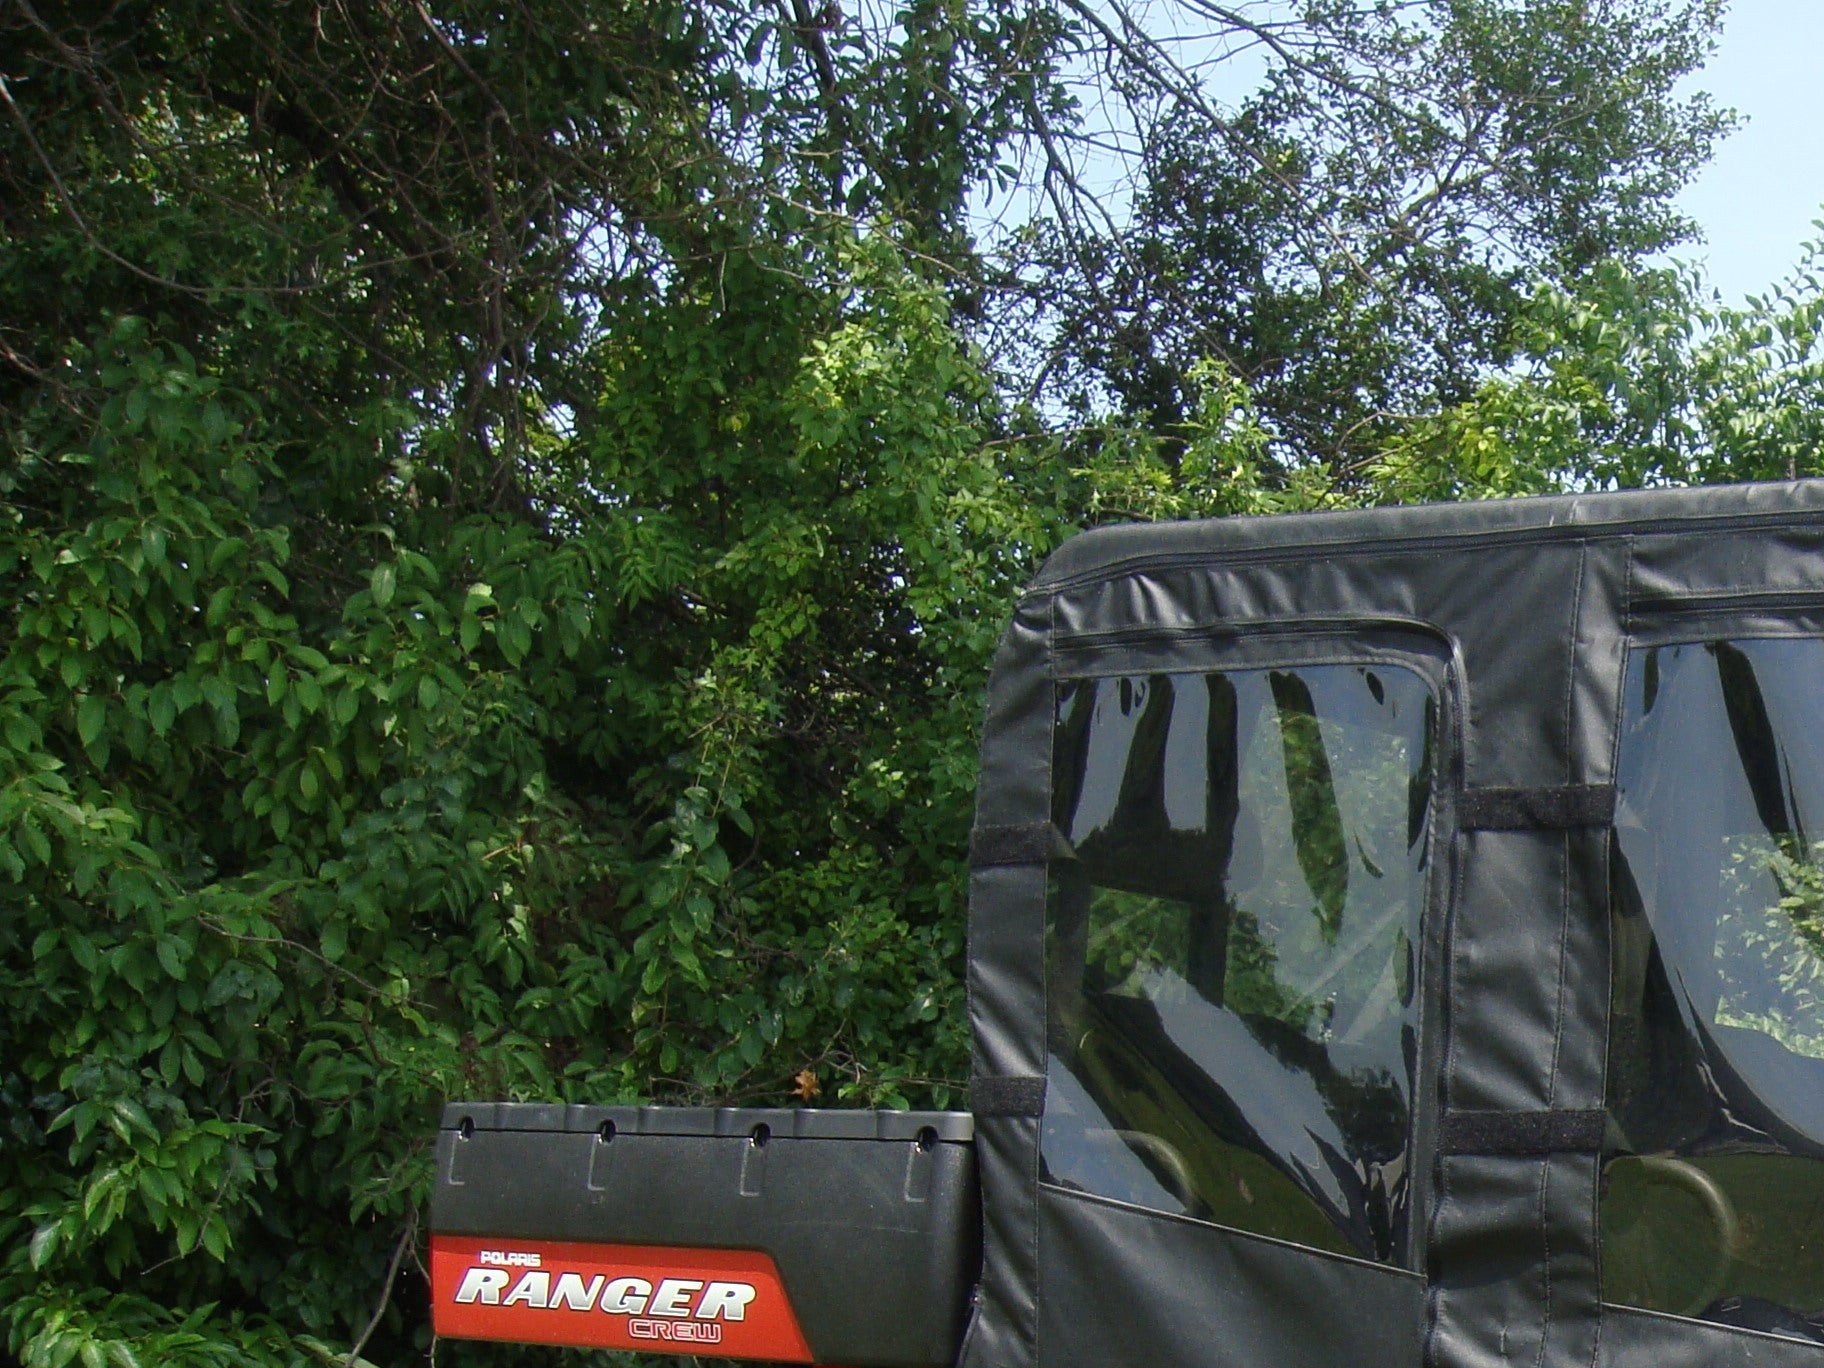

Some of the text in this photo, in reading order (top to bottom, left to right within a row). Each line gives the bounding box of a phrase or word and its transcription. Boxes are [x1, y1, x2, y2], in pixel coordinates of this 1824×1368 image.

[480, 1250, 542, 1268] POLARIS
[455, 1266, 757, 1322] RANGER
[628, 1318, 722, 1343] CREW
